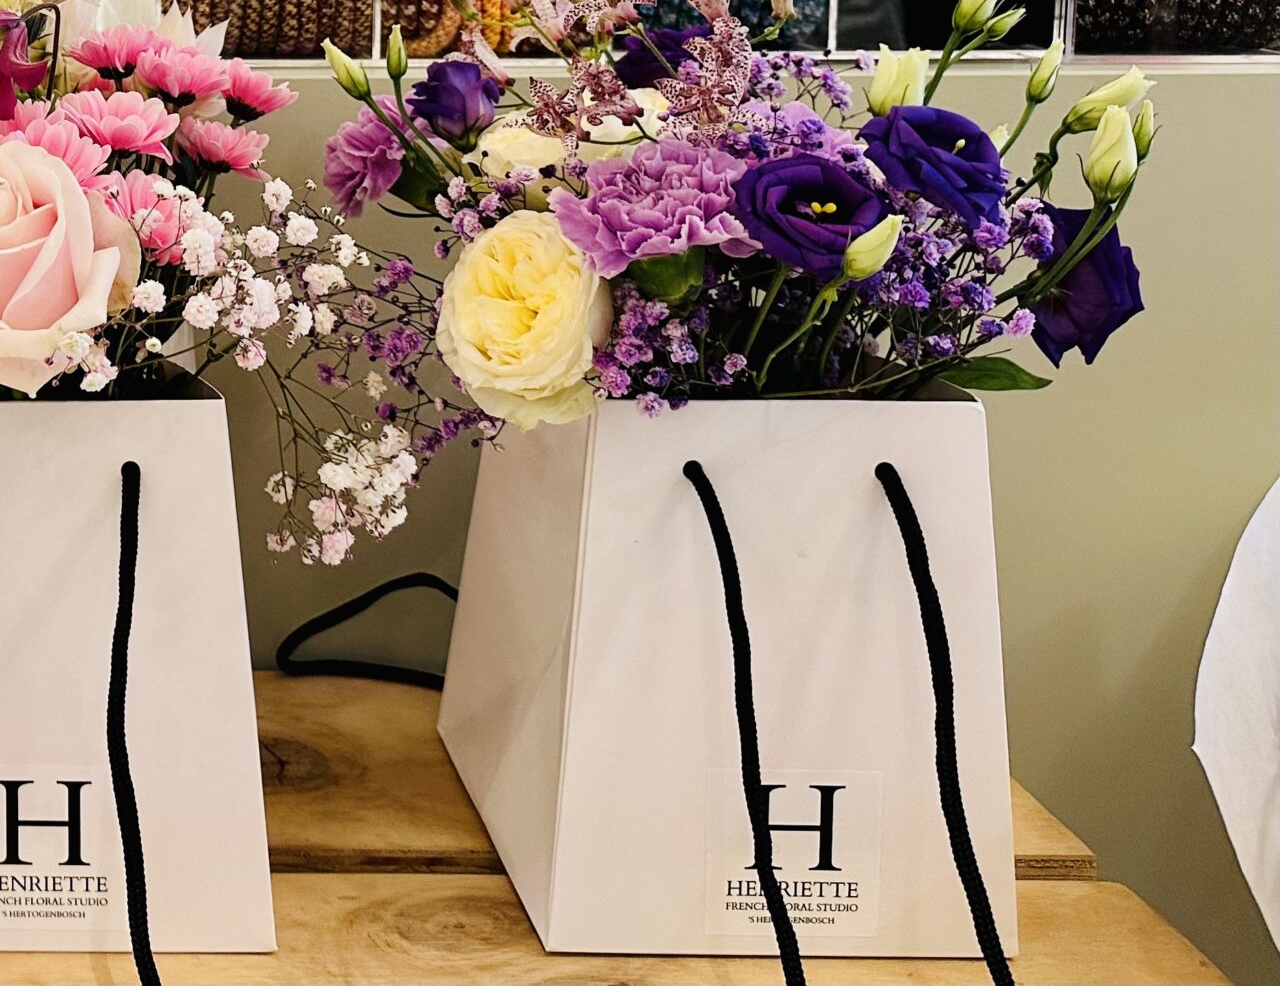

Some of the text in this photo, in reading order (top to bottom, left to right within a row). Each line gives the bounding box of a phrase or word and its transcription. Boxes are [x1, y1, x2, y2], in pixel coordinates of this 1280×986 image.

[744, 784, 846, 871] H
[24, 896, 65, 906] FLORAL
[66, 896, 109, 907] STUDIO
[782, 902, 814, 912] ORAL
[816, 903, 859, 912] STUDIO
[9, 910, 86, 918] HERTOGENBOSCH
